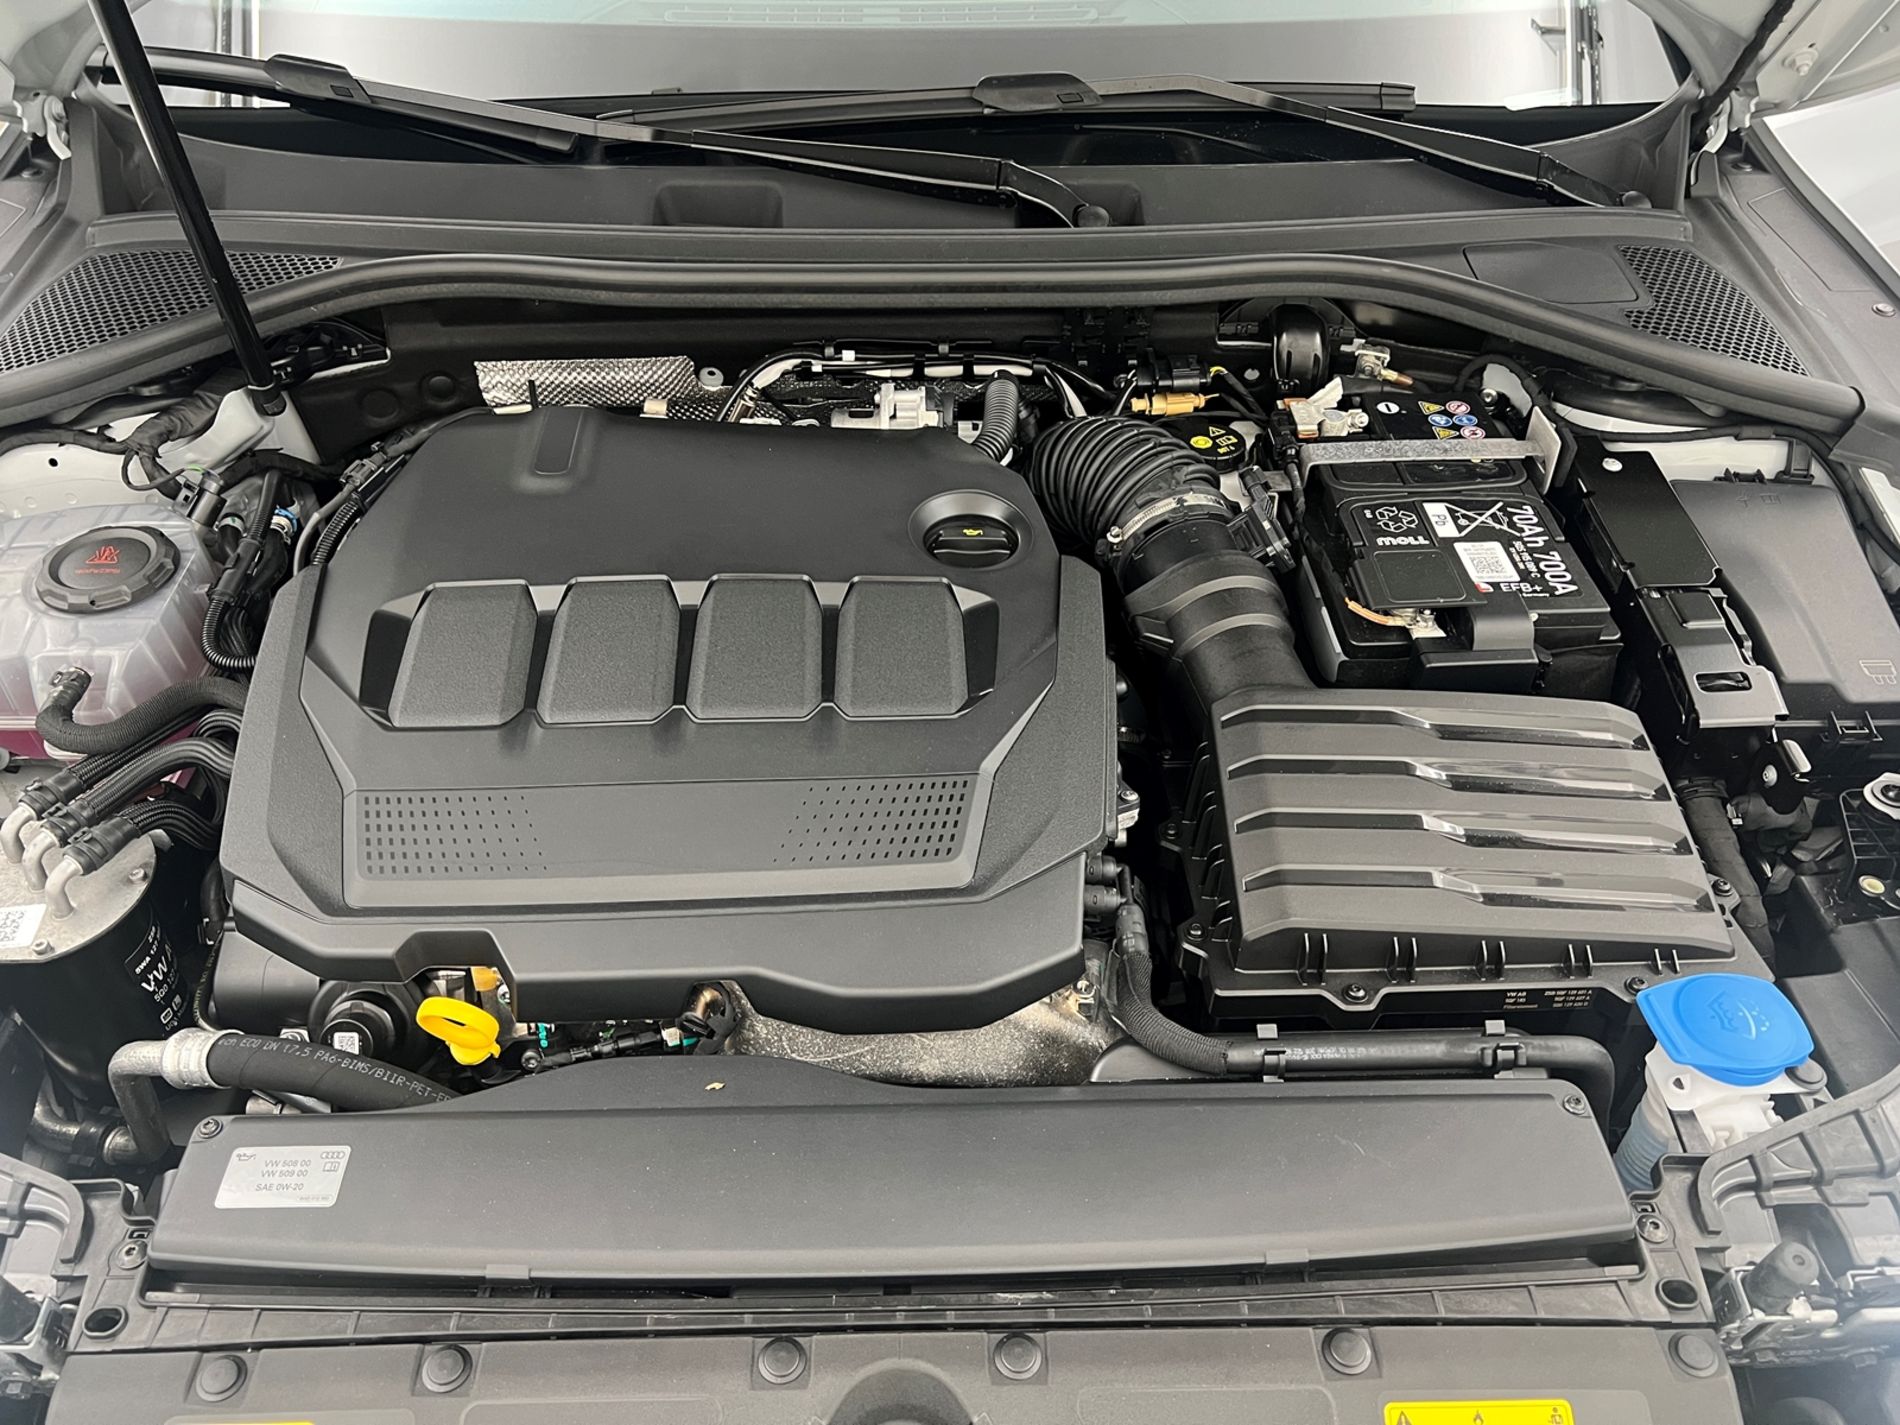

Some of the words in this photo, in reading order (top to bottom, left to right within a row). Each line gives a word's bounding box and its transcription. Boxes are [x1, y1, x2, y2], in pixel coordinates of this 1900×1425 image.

[1507, 505, 1550, 548] 70Ah
[1533, 551, 1579, 596] 700A
[1500, 582, 1543, 593] EFB+
[141, 956, 168, 992] VW
[263, 1040, 281, 1052] DN
[264, 1159, 280, 1167] VW
[299, 1159, 312, 1167] 00
[260, 1169, 277, 1178] VW
[297, 1169, 309, 1178] 00
[255, 1183, 274, 1192] SAE
[275, 1182, 305, 1191] 0W-20
